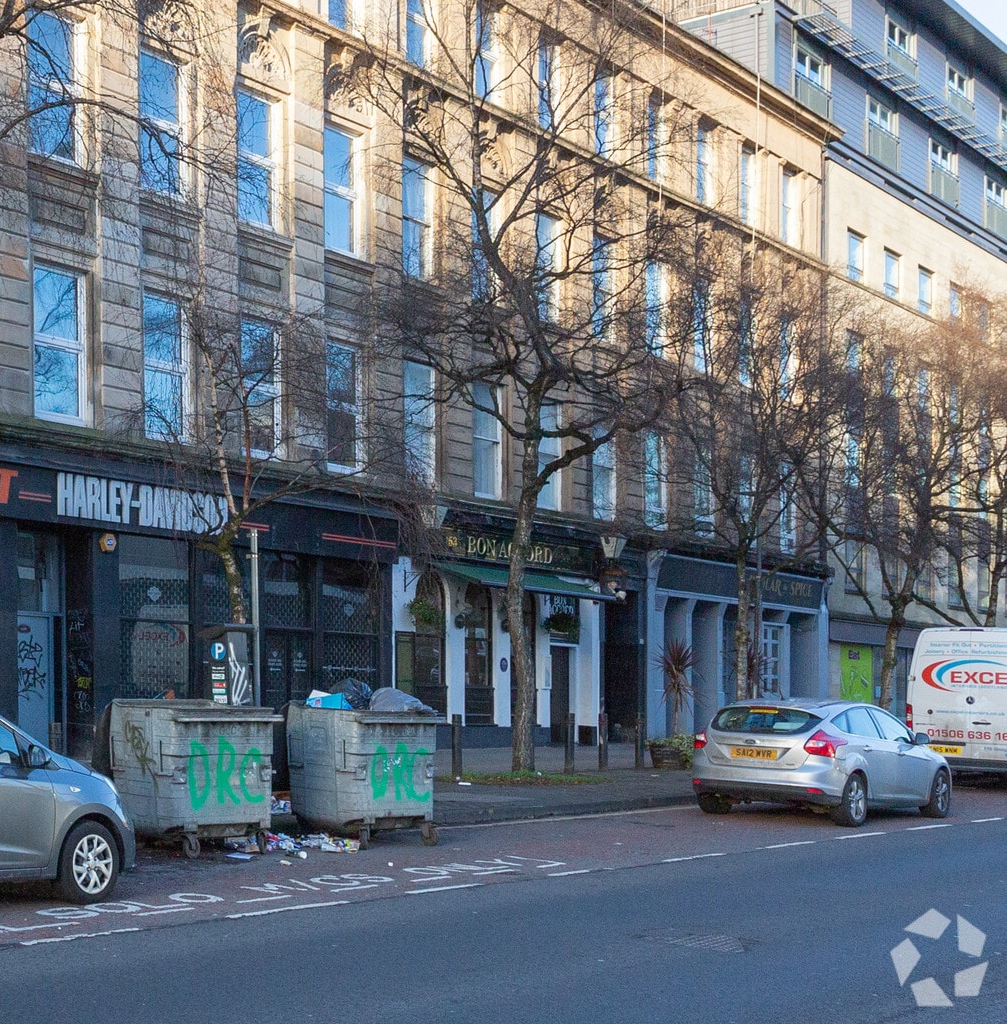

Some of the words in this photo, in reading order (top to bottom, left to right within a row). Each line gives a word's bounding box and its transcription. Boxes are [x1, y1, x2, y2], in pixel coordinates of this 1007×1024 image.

[56, 472, 229, 536] HARLEY-DAVIDSON
[467, 535, 496, 557] BON
[215, 643, 224, 659] P
[927, 728, 964, 739] 01506
[967, 730, 991, 740] 636
[736, 748, 754, 756] SA12
[36, 893, 225, 920] SOLO
